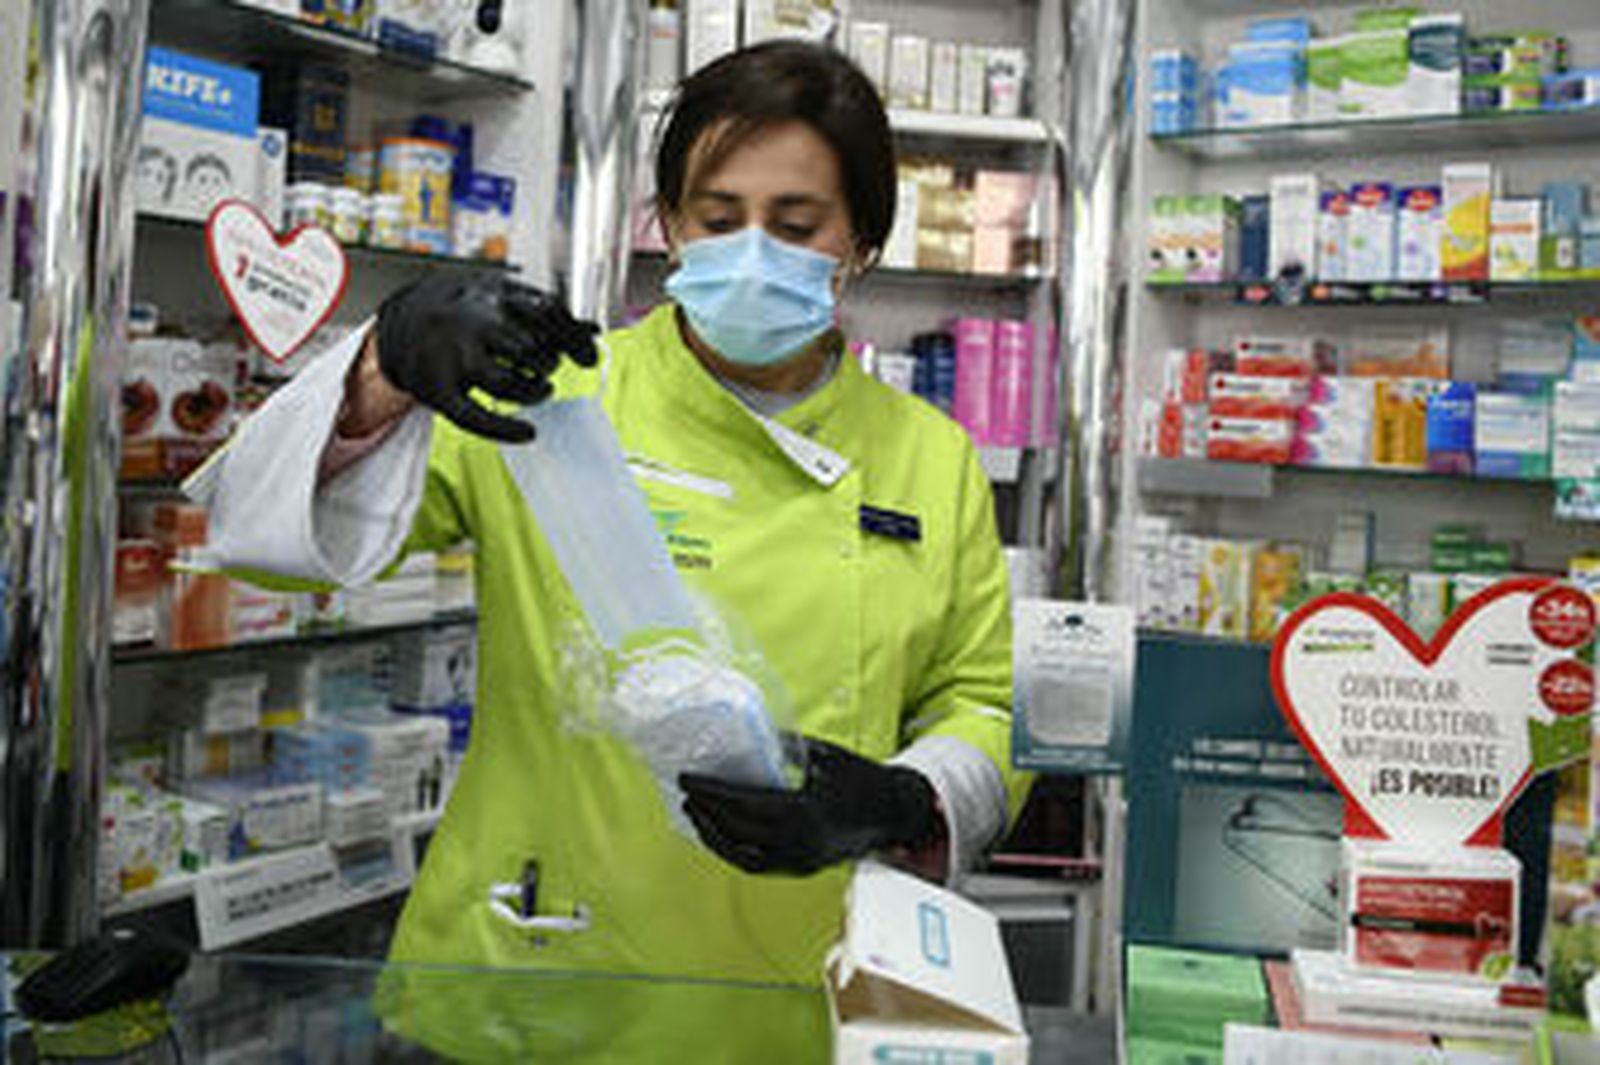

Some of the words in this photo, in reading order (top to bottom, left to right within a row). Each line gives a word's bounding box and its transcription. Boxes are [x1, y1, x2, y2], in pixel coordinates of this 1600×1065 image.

[1338, 672, 1461, 703] CONTROLAR
[1338, 705, 1366, 730] TU
[1370, 708, 1501, 739] COLESTEROL
[1340, 736, 1499, 770] NATURALMENTE
[1408, 773, 1500, 801] POSIBLE!
